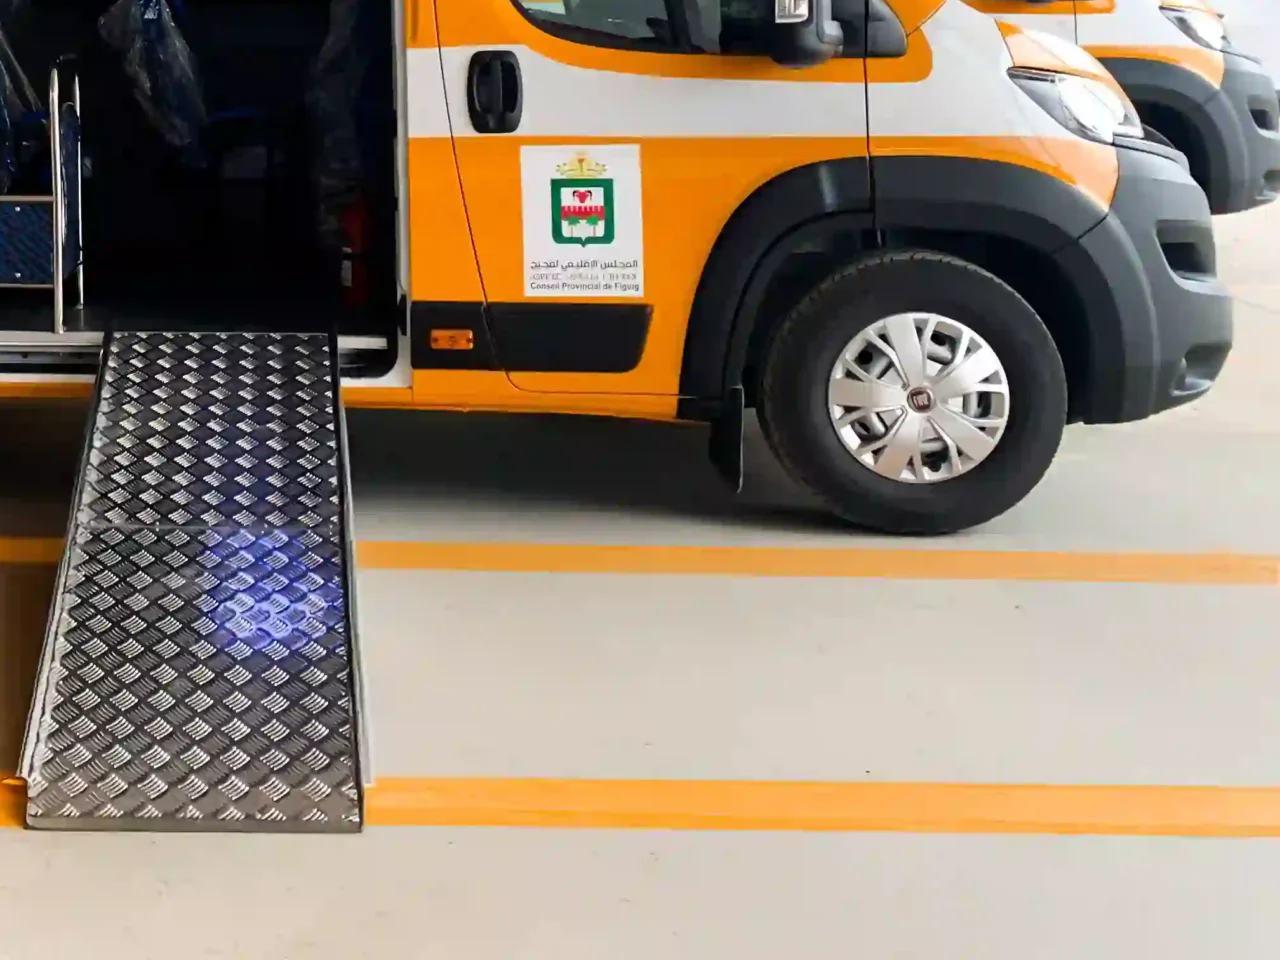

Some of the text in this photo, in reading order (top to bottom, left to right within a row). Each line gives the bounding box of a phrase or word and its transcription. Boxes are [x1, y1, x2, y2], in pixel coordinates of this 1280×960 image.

[530, 282, 560, 290] Conseil
[562, 281, 601, 290] Provincial
[603, 281, 613, 290] de
